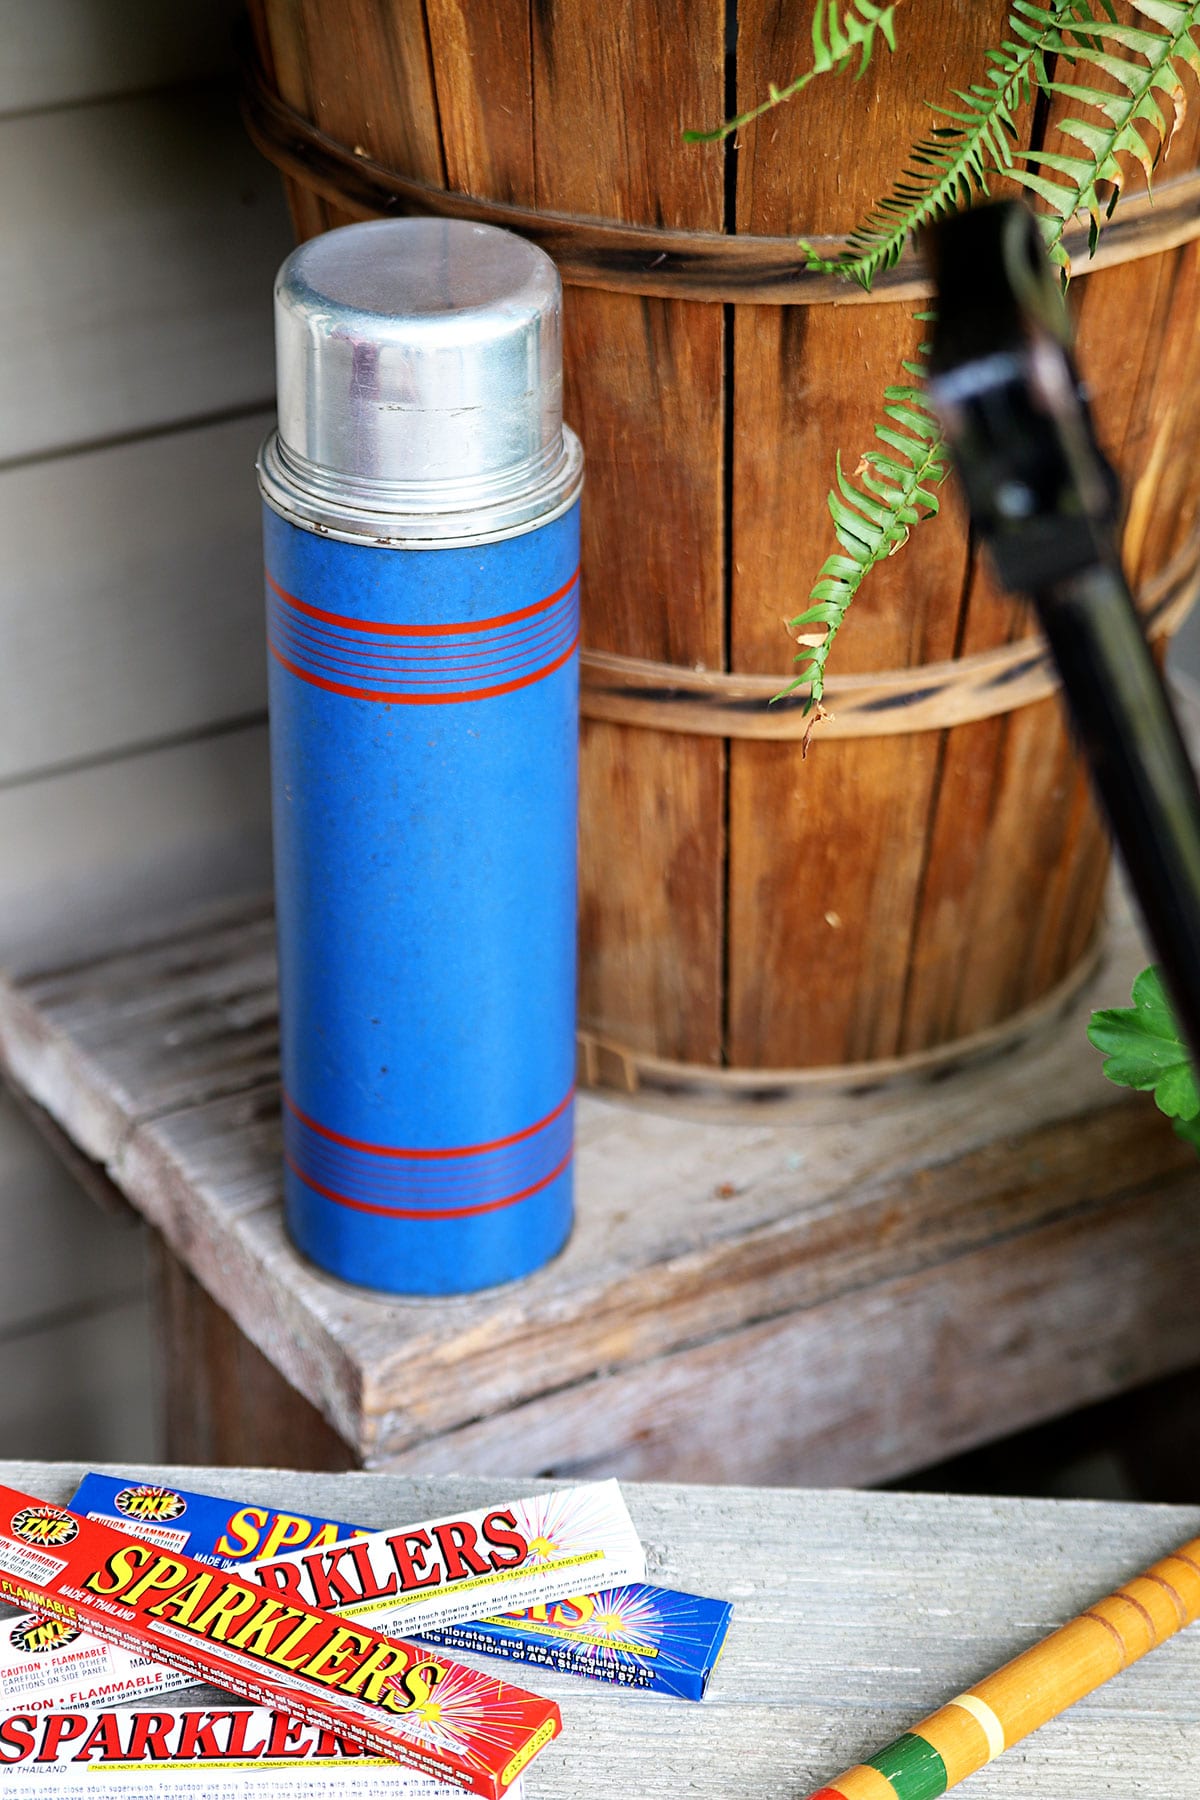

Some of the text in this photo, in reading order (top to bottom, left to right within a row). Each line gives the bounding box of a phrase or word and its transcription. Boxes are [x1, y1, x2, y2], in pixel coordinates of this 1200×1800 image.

[127, 1495, 174, 1514] TNT
[19, 1517, 68, 1538] TNT
[133, 1525, 185, 1542] FLAMMABLE
[153, 1537, 180, 1549] OTHER
[7, 1562, 45, 1583] SIDE PANEL
[9, 1554, 30, 1567] READ
[29, 1562, 54, 1577] OTHER
[16, 1546, 63, 1571] FLAMMABLE
[192, 1551, 232, 1569] MADE IN
[257, 1509, 529, 1611] RKLERS
[344, 1605, 374, 1617] SUITABLE
[389, 1588, 442, 1606] RECOMMENDED
[444, 1584, 461, 1593] FOR
[463, 1576, 494, 1588] CHILDREN
[507, 1568, 528, 1579] YEARS
[541, 1562, 555, 1570] AGE
[556, 1558, 574, 1567] AND
[575, 1552, 599, 1562] UNDER
[2, 1580, 76, 1619] FLAMMABLE
[56, 1582, 136, 1622] MADE IN THAILAND
[83, 1545, 448, 1714] SPARKLERS
[392, 1619, 402, 1628] Do
[403, 1616, 416, 1625] not
[417, 1611, 438, 1622] touch
[440, 1603, 469, 1616] glowing
[22, 1619, 65, 1647] TNT
[485, 1615, 521, 1628] PACKAGE
[524, 1623, 541, 1632] CAN
[542, 1627, 562, 1636] ONLY
[563, 1631, 574, 1639] BE
[576, 1634, 598, 1644] SOLD
[617, 1643, 655, 1656] PACKAGE
[0, 1645, 108, 1679] CAUTION FLAMMABLE
[421, 1632, 441, 1643] the
[444, 1635, 510, 1658] provisions
[511, 1649, 524, 1660] of
[527, 1653, 555, 1666] APA
[556, 1659, 614, 1678] Standard
[499, 1638, 523, 1651] and
[526, 1644, 547, 1656] are
[550, 1649, 572, 1661] not
[573, 1654, 635, 1675] regulated
[638, 1667, 655, 1678] as
[1, 1655, 108, 1688] CAREFULLY READ OTHER
[3, 1663, 107, 1697] CAUTIONS ON SIDE PANEL
[70, 1672, 163, 1702] FLAMMABLE
[92, 1697, 105, 1706] end
[107, 1696, 115, 1704] or
[117, 1689, 142, 1702] sparks
[144, 1684, 163, 1695] away
[165, 1678, 182, 1688] from
[17, 1766, 68, 1774] THAILAND
